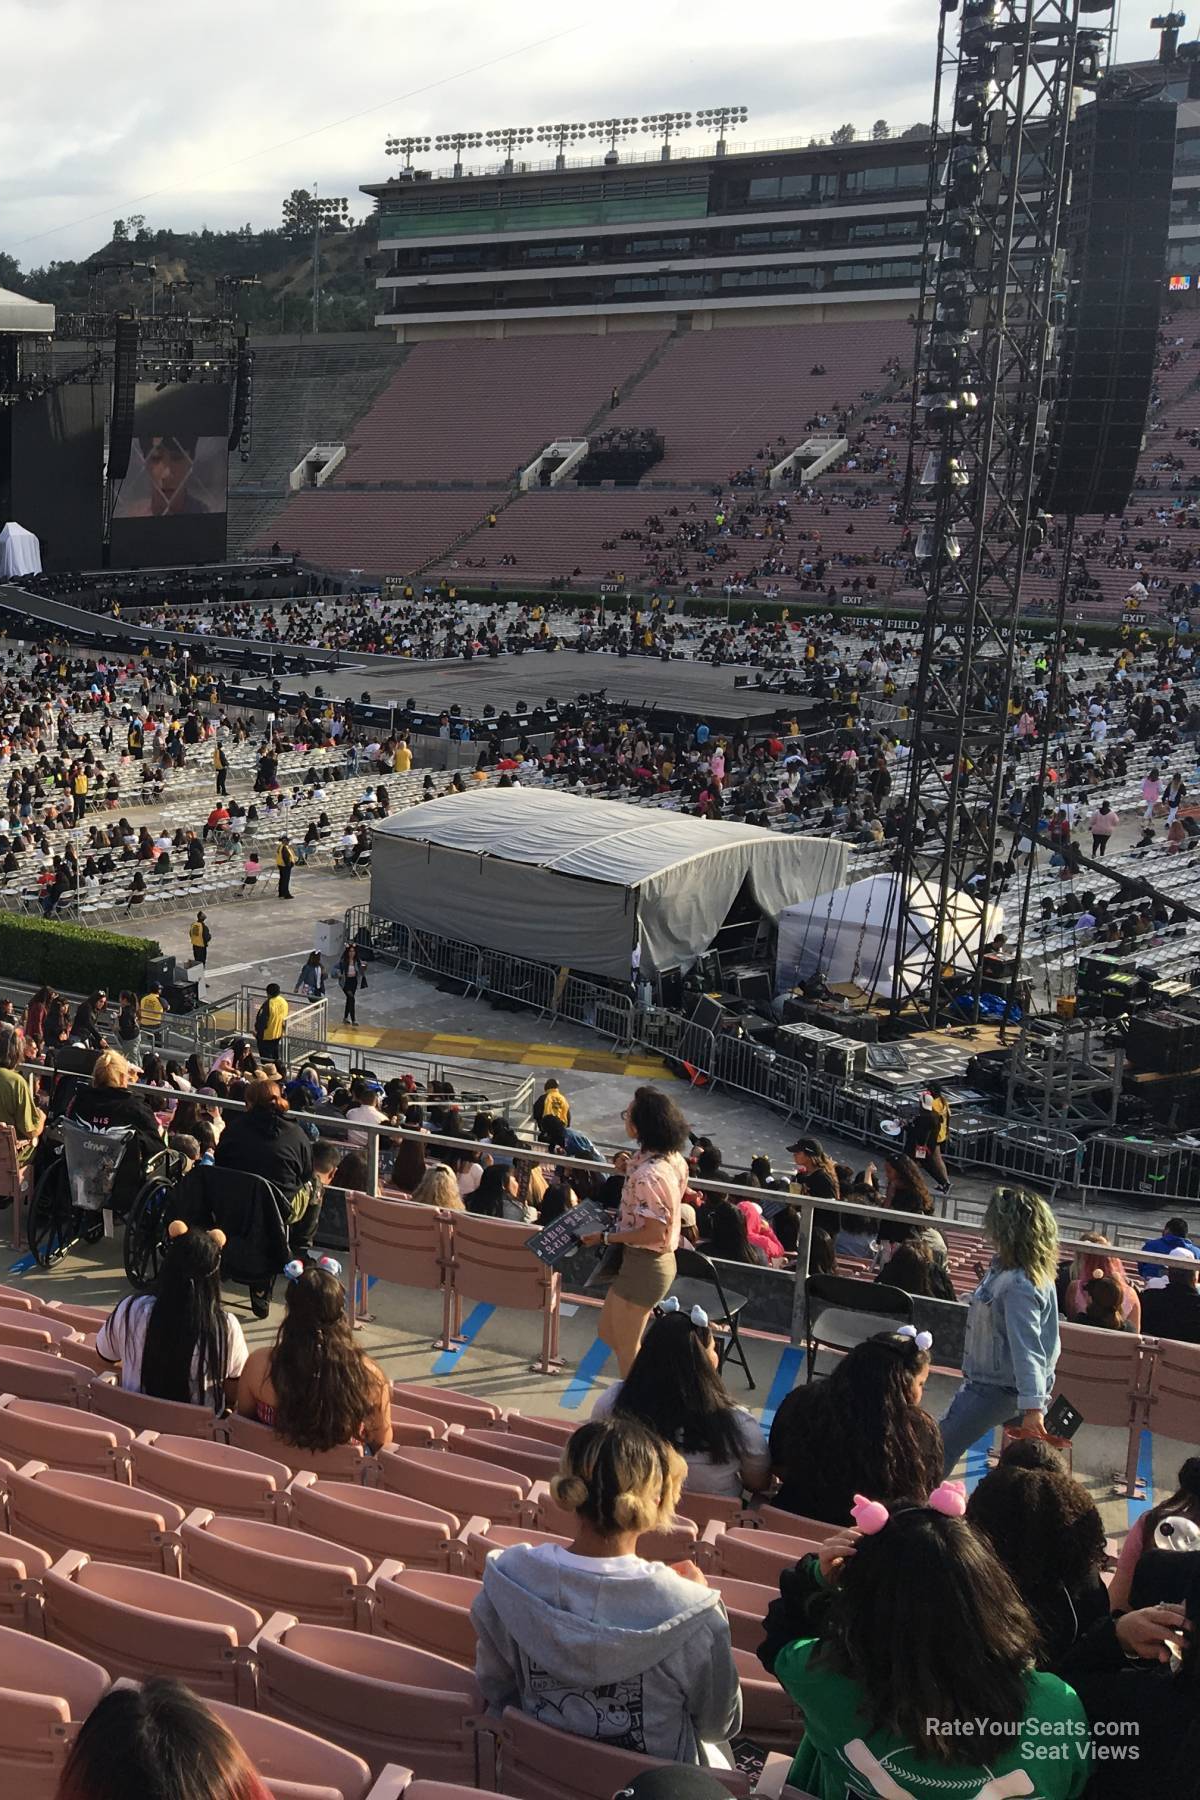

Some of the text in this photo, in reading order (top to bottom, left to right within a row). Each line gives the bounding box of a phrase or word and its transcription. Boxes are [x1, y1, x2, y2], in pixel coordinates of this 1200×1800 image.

[385, 576, 403, 584] EXIT
[600, 584, 618, 592] EXIT
[842, 596, 862, 605] EXIT
[1122, 613, 1146, 623] EXIT
[887, 619, 920, 630] FIELD
